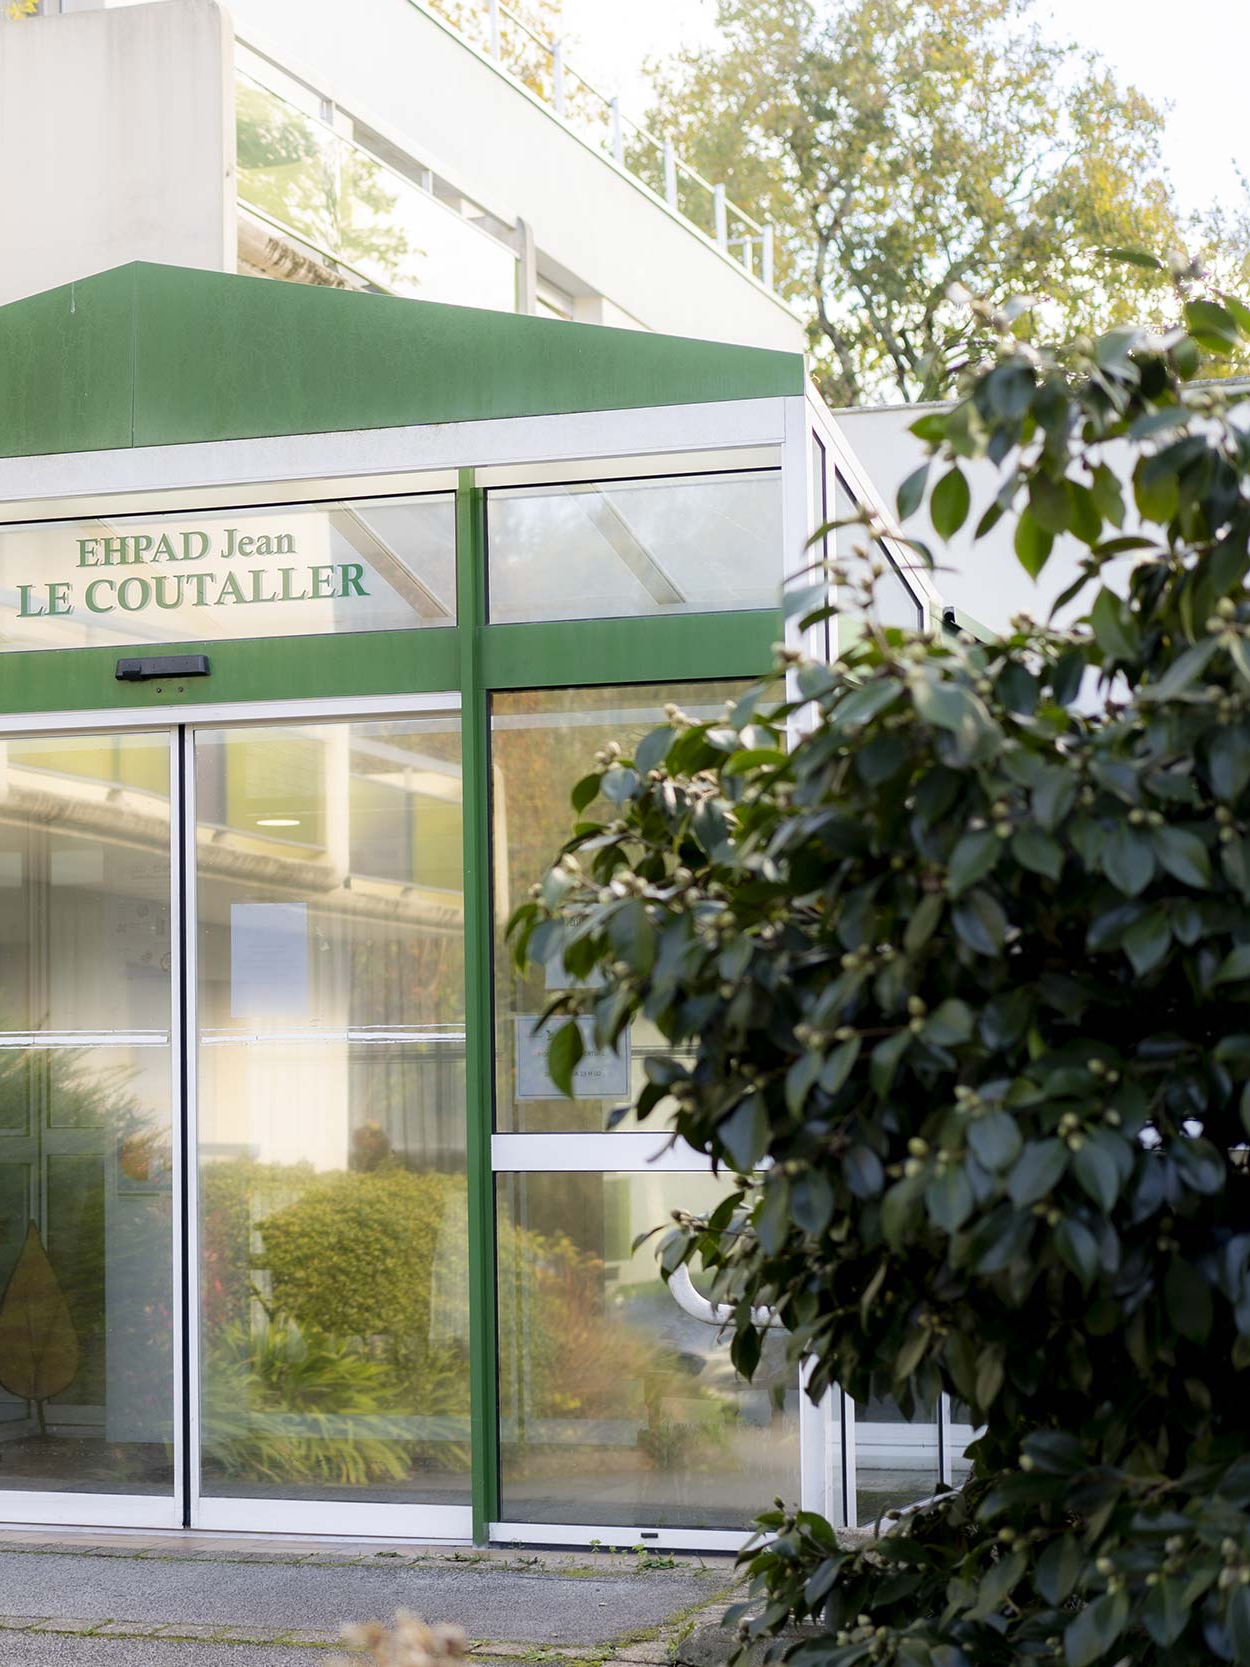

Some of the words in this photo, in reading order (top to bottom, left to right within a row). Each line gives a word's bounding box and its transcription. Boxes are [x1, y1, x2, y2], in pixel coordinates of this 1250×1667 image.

[76, 530, 211, 568] EHPAD
[220, 528, 297, 559] Jean
[15, 581, 73, 618] LE
[84, 562, 371, 613] COUTALLER
